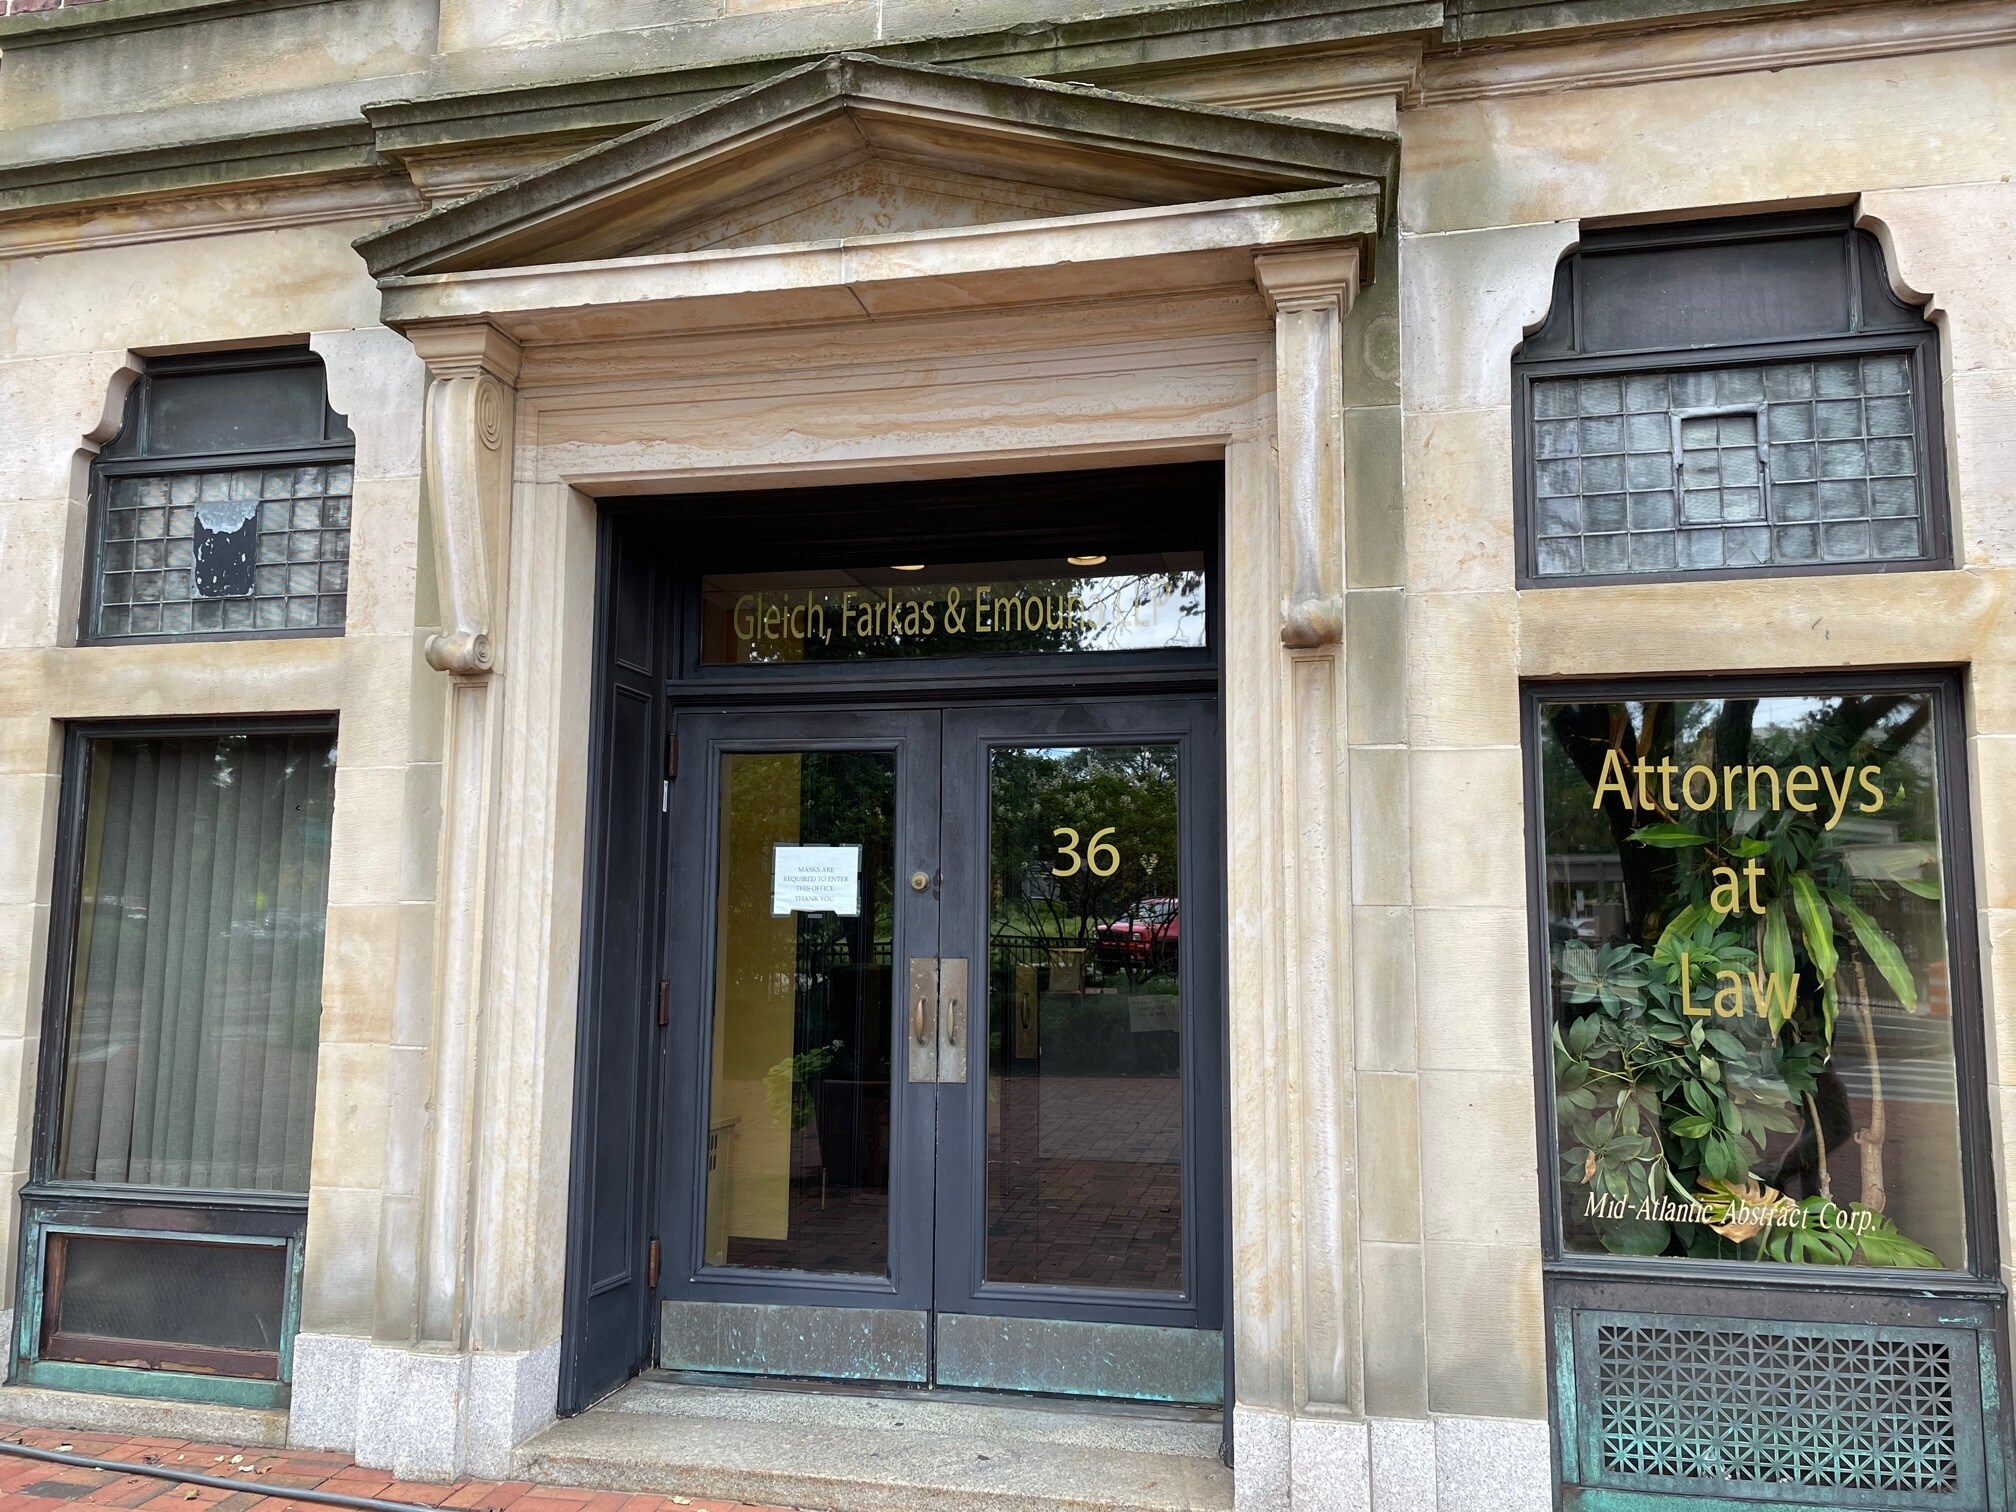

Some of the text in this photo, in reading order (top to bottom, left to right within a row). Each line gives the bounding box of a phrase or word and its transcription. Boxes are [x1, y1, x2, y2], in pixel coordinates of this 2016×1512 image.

[733, 590, 833, 646] Gleich,
[842, 587, 935, 637] Farkas
[943, 586, 967, 634] &
[1591, 748, 1885, 831] Attorneys
[1051, 826, 1121, 877] 36
[1709, 857, 1767, 915] at
[1680, 952, 1801, 1020] Law
[1583, 1190, 1877, 1237] Mid-Atlantic Abstract Corp.
